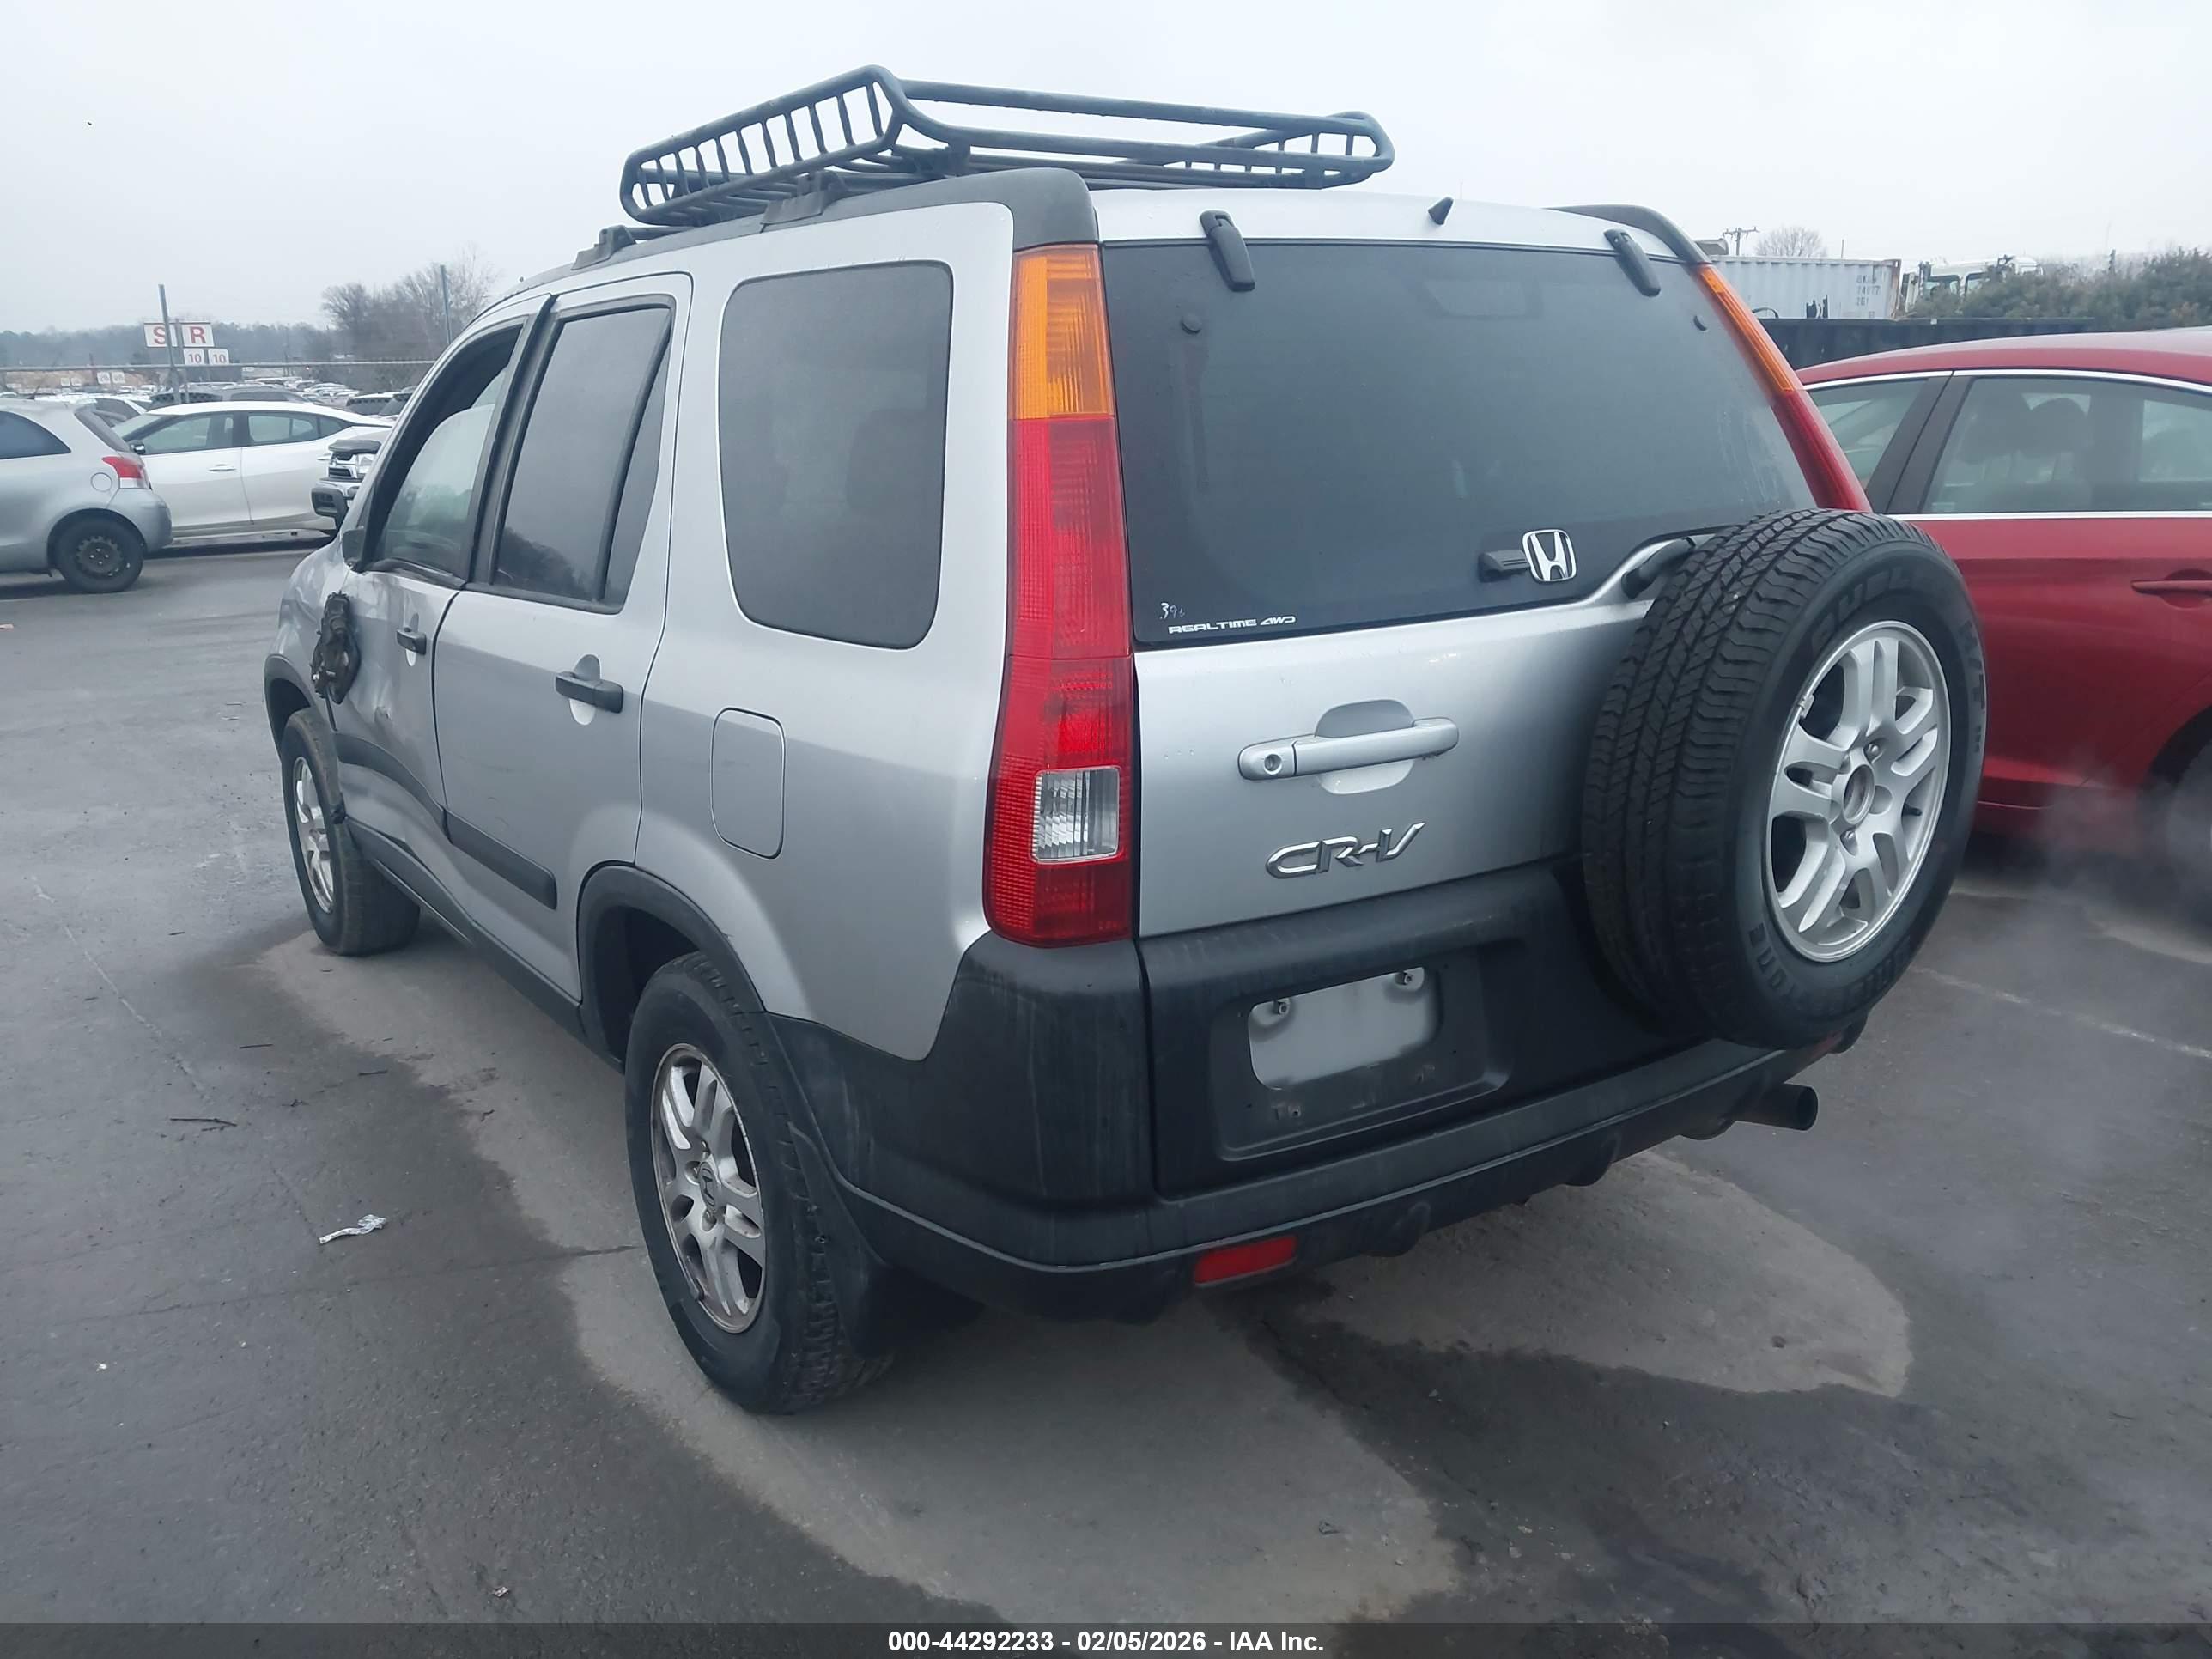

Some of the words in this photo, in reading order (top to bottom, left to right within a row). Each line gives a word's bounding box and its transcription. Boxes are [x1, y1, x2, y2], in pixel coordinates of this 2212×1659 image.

[153, 326, 167, 345] S
[189, 325, 207, 344] R
[189, 353, 202, 364] 10
[212, 353, 227, 364] 10
[1168, 618, 1257, 635] REALTIME
[1266, 822, 1426, 879] CR-V
